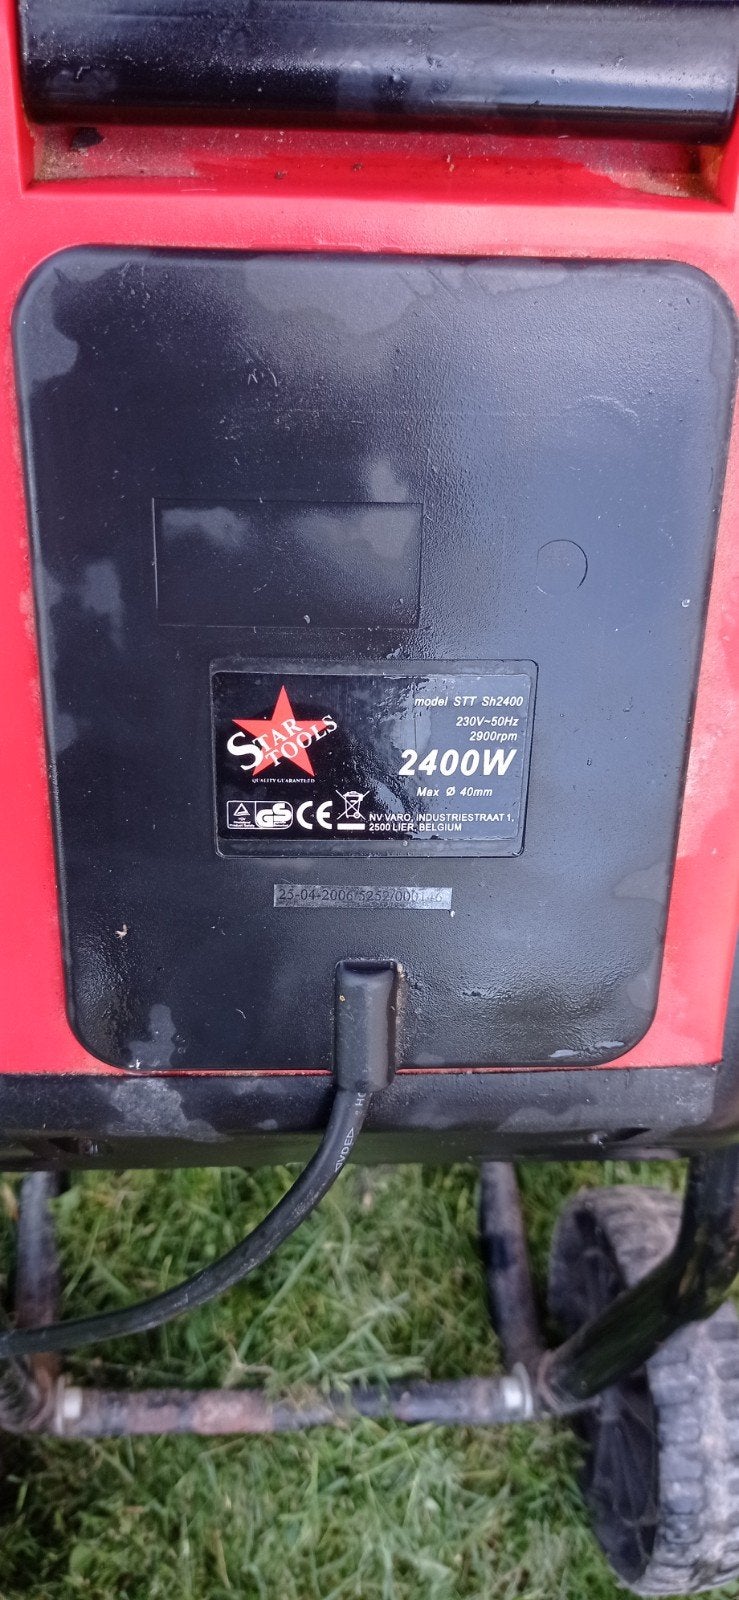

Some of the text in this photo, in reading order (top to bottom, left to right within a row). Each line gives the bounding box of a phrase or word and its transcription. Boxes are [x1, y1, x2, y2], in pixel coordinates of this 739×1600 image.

[415, 696, 523, 708] model STT Sh2400
[456, 717, 519, 727] 230V~50Hz
[265, 715, 337, 767] TOOLS
[470, 732, 518, 742] 2900rpm
[227, 718, 303, 771] STAR
[399, 749, 517, 776] 2400W
[417, 787, 439, 797] Max
[460, 787, 493, 797] 40mm
[256, 802, 292, 828] GS
[297, 801, 333, 830] CE
[416, 813, 505, 821] INDUSTRIESTRAAT
[369, 823, 390, 831] 2500
[419, 823, 462, 831] BELGIUM
